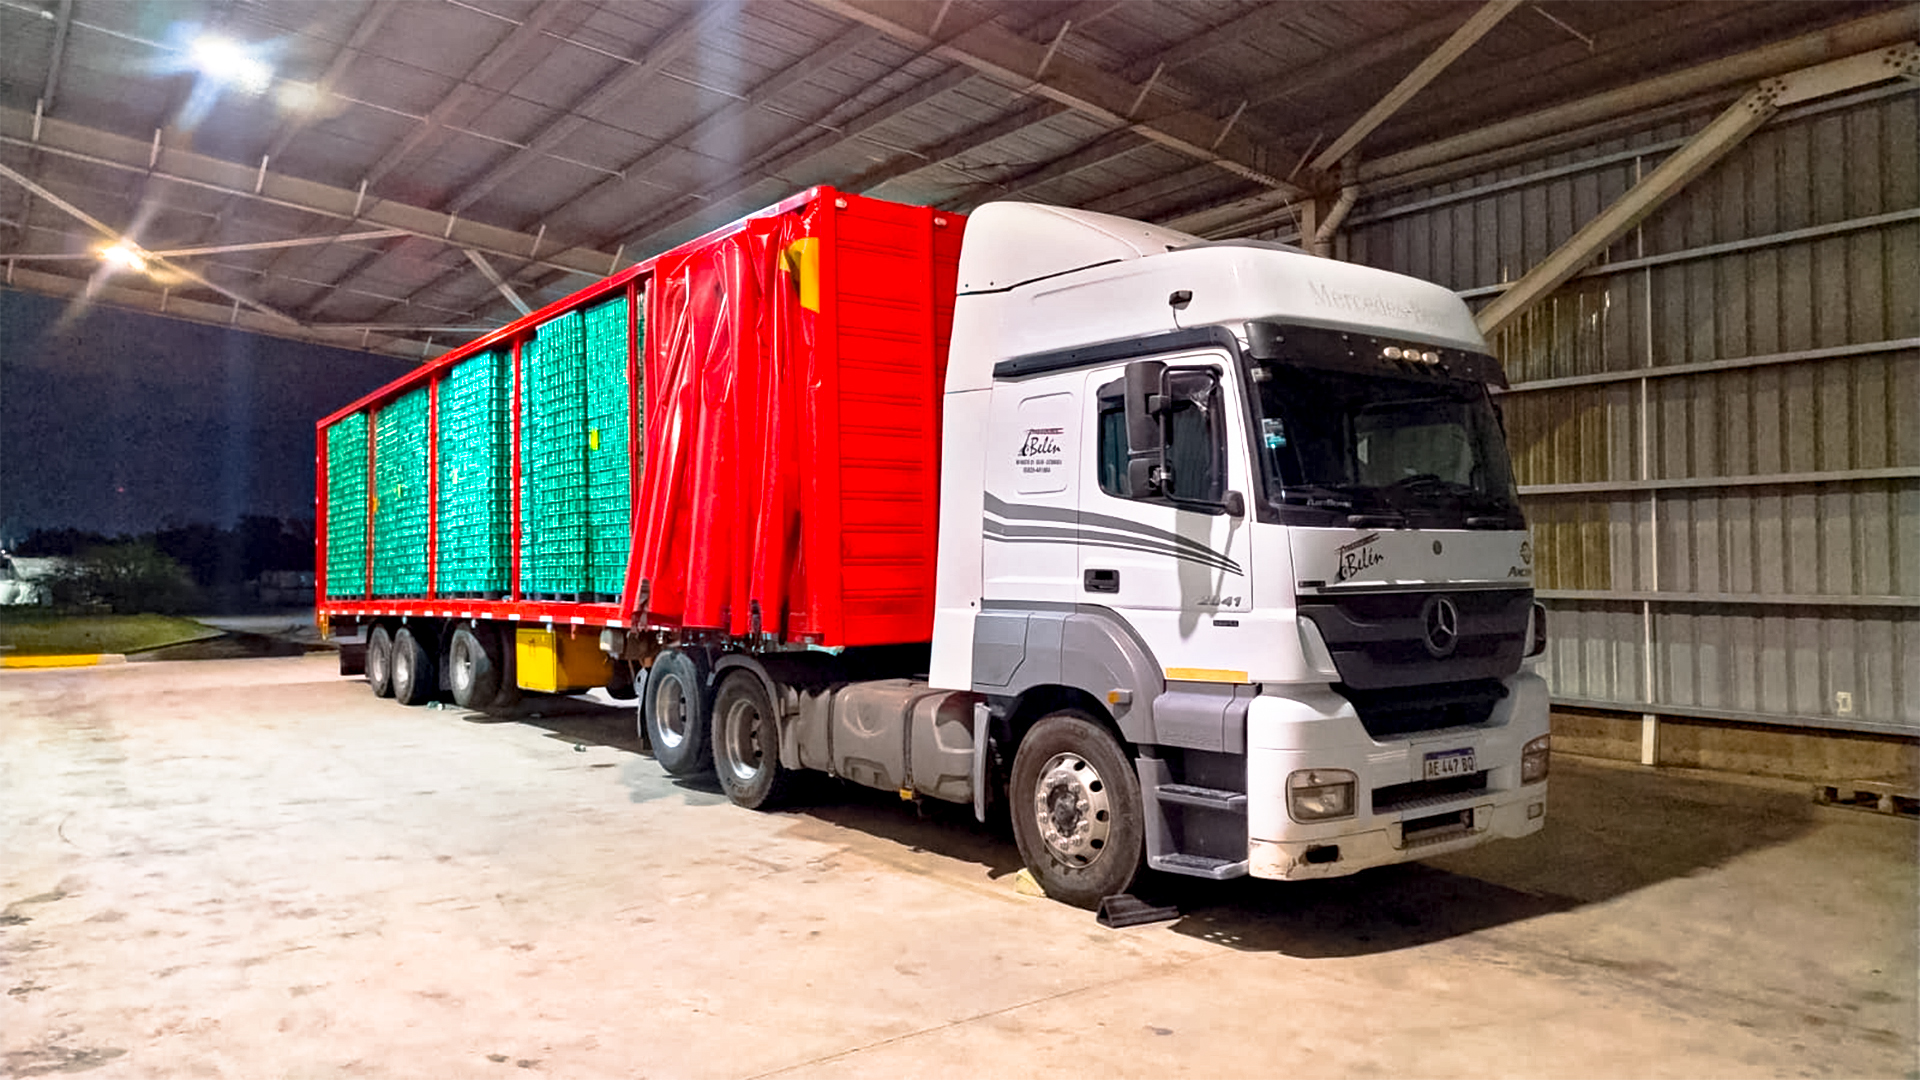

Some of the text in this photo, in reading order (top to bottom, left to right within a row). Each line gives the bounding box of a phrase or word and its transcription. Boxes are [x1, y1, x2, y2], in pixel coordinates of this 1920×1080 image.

[1308, 279, 1448, 326] Mercedes-B
[1030, 436, 1061, 456] Belén
[1345, 547, 1384, 578] Belén
[1429, 761, 1440, 776] AE
[1442, 758, 1458, 773] 447
